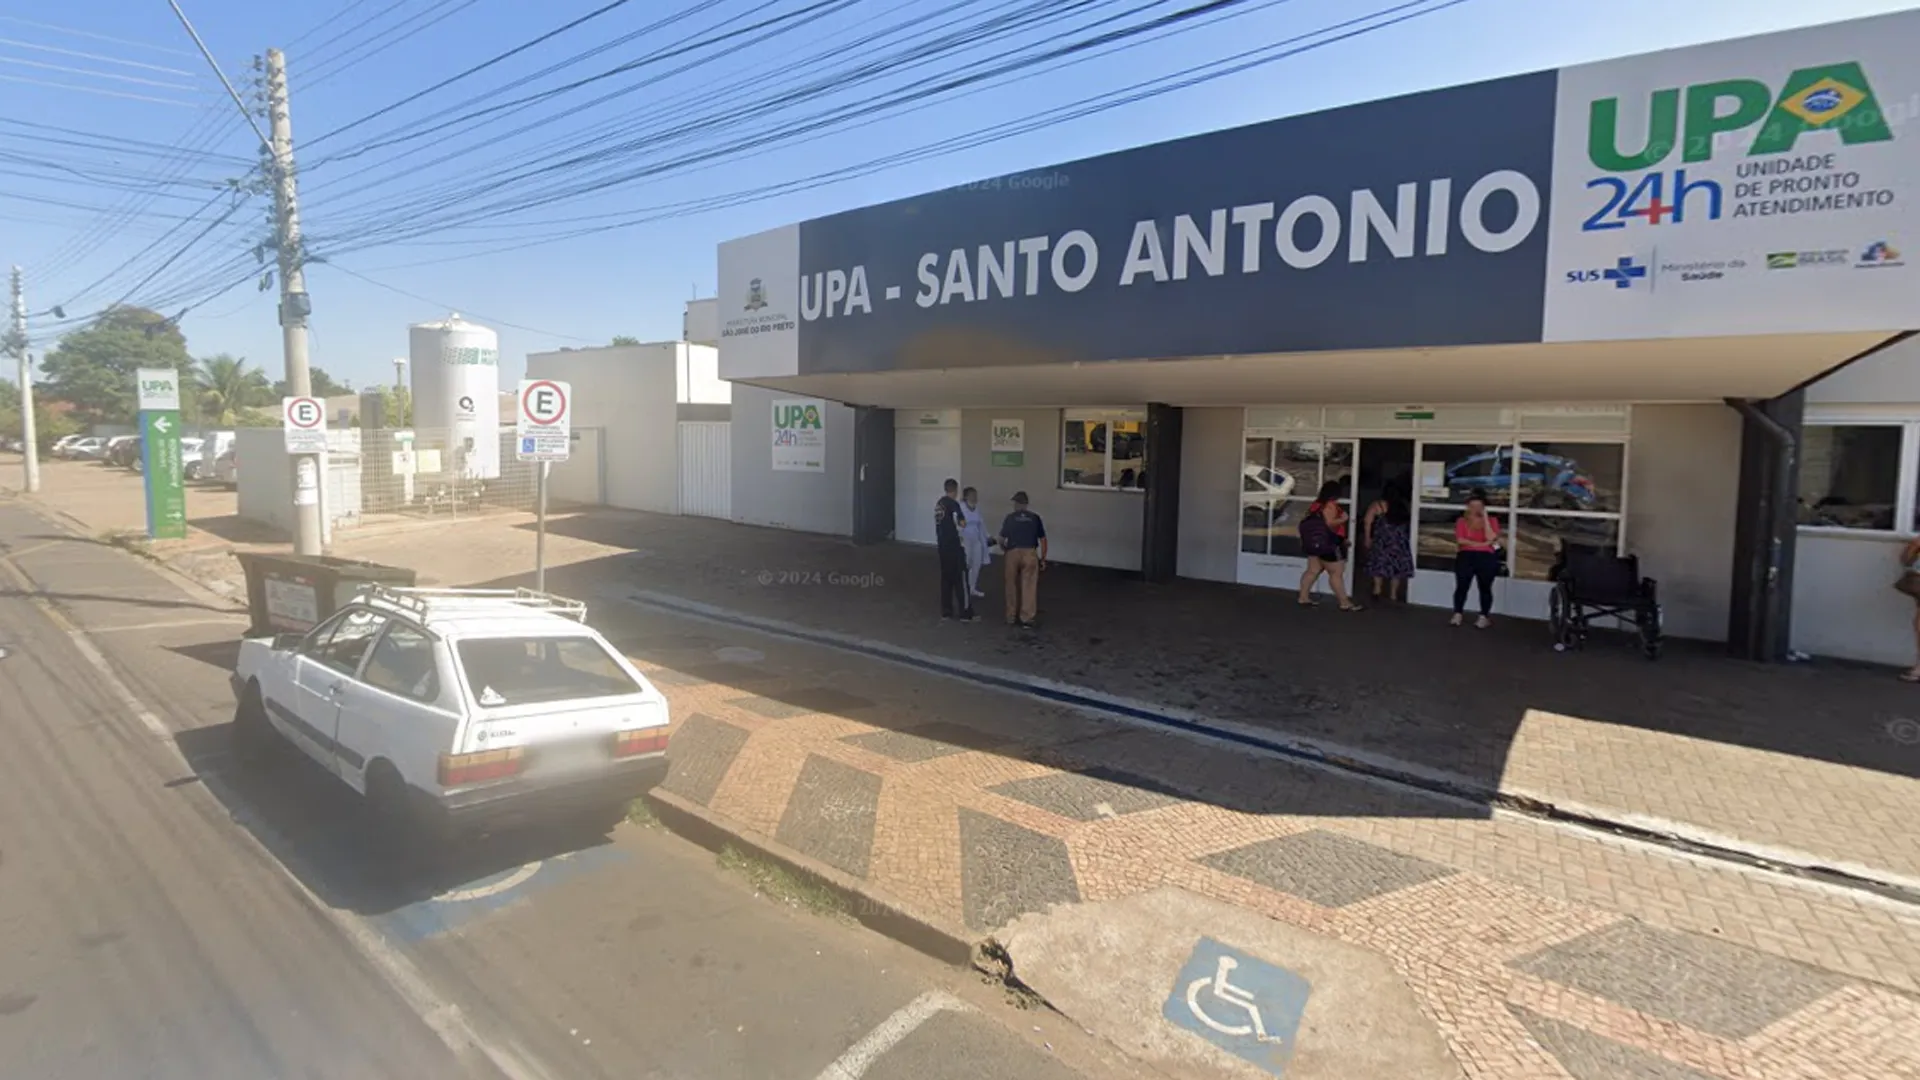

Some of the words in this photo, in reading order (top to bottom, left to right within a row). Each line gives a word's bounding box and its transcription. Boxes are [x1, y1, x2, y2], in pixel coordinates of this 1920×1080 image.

[1587, 60, 1895, 172] UPA
[1736, 153, 1836, 179] UNIDADE
[1734, 181, 1762, 198] DE
[1769, 171, 1860, 195] PRONTO
[1582, 168, 1722, 231] 24h
[1732, 189, 1894, 218] ATENDIMENTO
[800, 265, 872, 321] UPA
[915, 230, 1099, 308] SANTO
[1118, 169, 1541, 286] ANTONIO
[1566, 269, 1600, 283] SUS
[141, 379, 174, 391] UPA
[299, 405, 311, 420] E
[536, 391, 553, 414] E
[775, 405, 822, 430] UPA
[775, 430, 797, 446] 24h
[994, 427, 1020, 438] UPA
